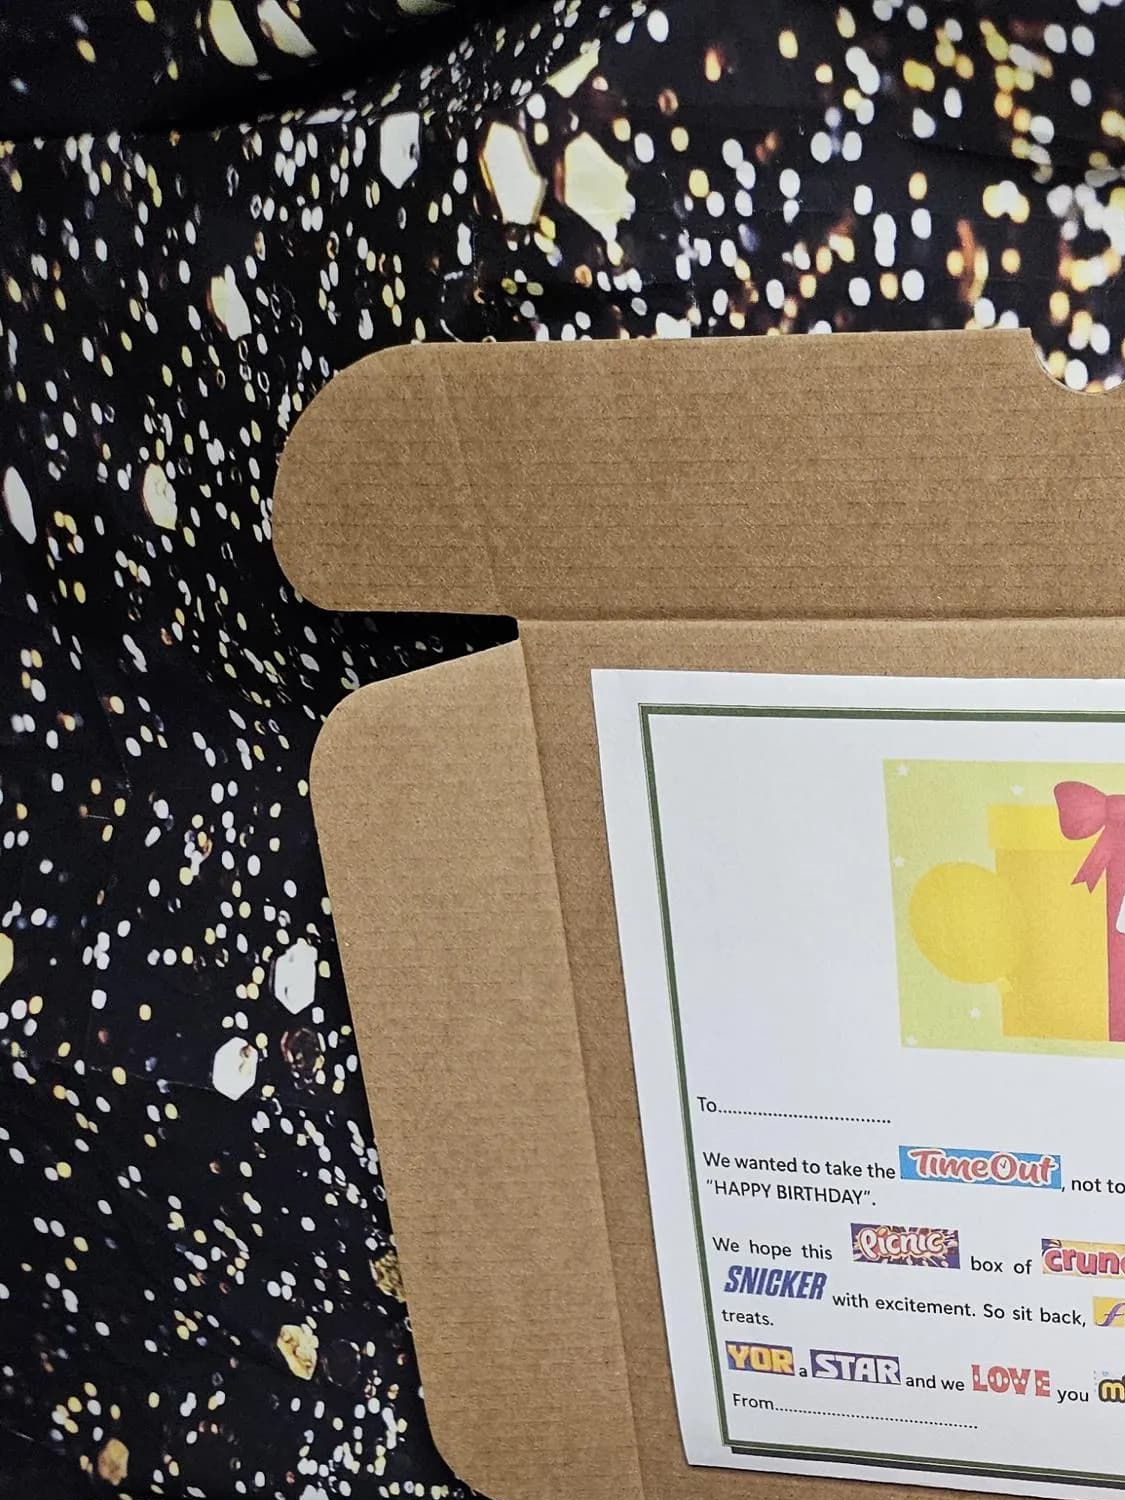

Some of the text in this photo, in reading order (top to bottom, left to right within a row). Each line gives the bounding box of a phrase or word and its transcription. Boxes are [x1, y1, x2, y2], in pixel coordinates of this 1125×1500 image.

[703, 1151, 731, 1169] We
[734, 1155, 797, 1174] wanted
[801, 1159, 820, 1175] to
[825, 1158, 863, 1178] take
[866, 1160, 896, 1179] the
[1071, 1177, 1102, 1194] not
[1106, 1178, 1125, 1194] to
[713, 1237, 740, 1254] We
[749, 1240, 792, 1262] hope
[801, 1242, 833, 1261] this
[857, 1226, 948, 1261] Picnic
[971, 1255, 1003, 1273] box
[1013, 1257, 1032, 1274] of
[722, 1309, 774, 1327] treats.
[724, 1265, 827, 1301] SNICKER
[832, 1292, 869, 1310] with
[875, 1294, 975, 1317] excitement.
[983, 1303, 1005, 1320] So
[1012, 1303, 1032, 1322] sit
[1040, 1306, 1086, 1327] back,
[727, 1344, 794, 1373] YOR
[799, 1366, 808, 1378] a
[814, 1353, 901, 1384] STAR
[905, 1372, 937, 1390] and
[941, 1378, 965, 1392] we
[971, 1363, 1050, 1397] LOVE
[1057, 1387, 1089, 1404] you
